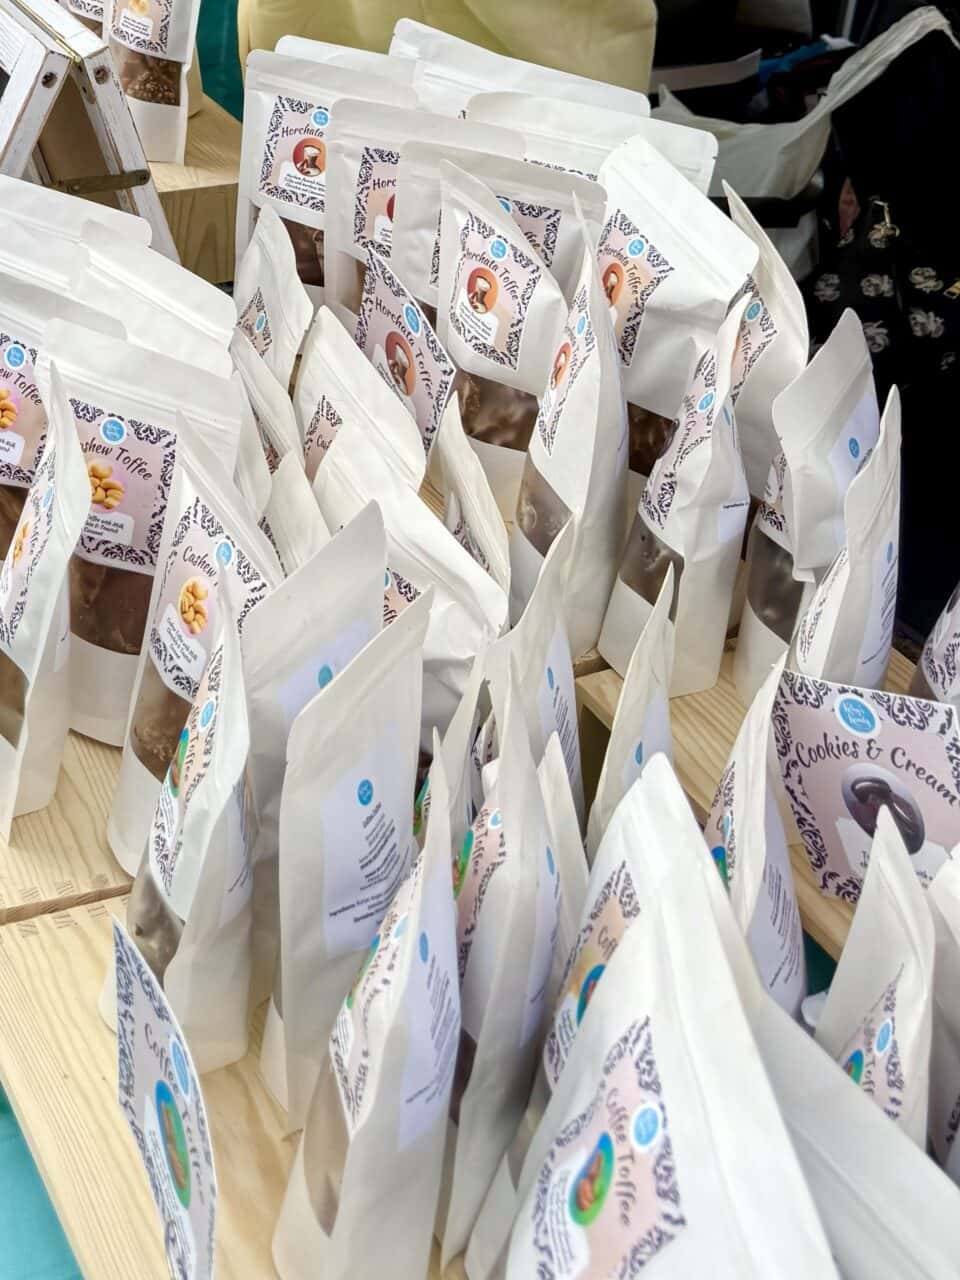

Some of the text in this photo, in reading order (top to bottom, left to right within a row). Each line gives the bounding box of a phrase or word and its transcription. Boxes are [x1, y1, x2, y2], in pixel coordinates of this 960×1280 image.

[281, 123, 325, 138] Horchata
[372, 177, 397, 191] Horc
[523, 231, 541, 250] ffee
[497, 266, 519, 301] Toffee
[625, 263, 642, 297] Toffee
[374, 295, 435, 400] Horchata Toffee
[13, 371, 43, 406] Toffee
[115, 447, 153, 481] Toffee
[182, 545, 217, 578] Cashew
[795, 732, 860, 769] Cookies
[866, 737, 884, 761] &
[471, 829, 488, 876] Toffee
[597, 925, 619, 961] Coff
[863, 1059, 876, 1096] Toff
[605, 1086, 637, 1228] Coffee Toffee
